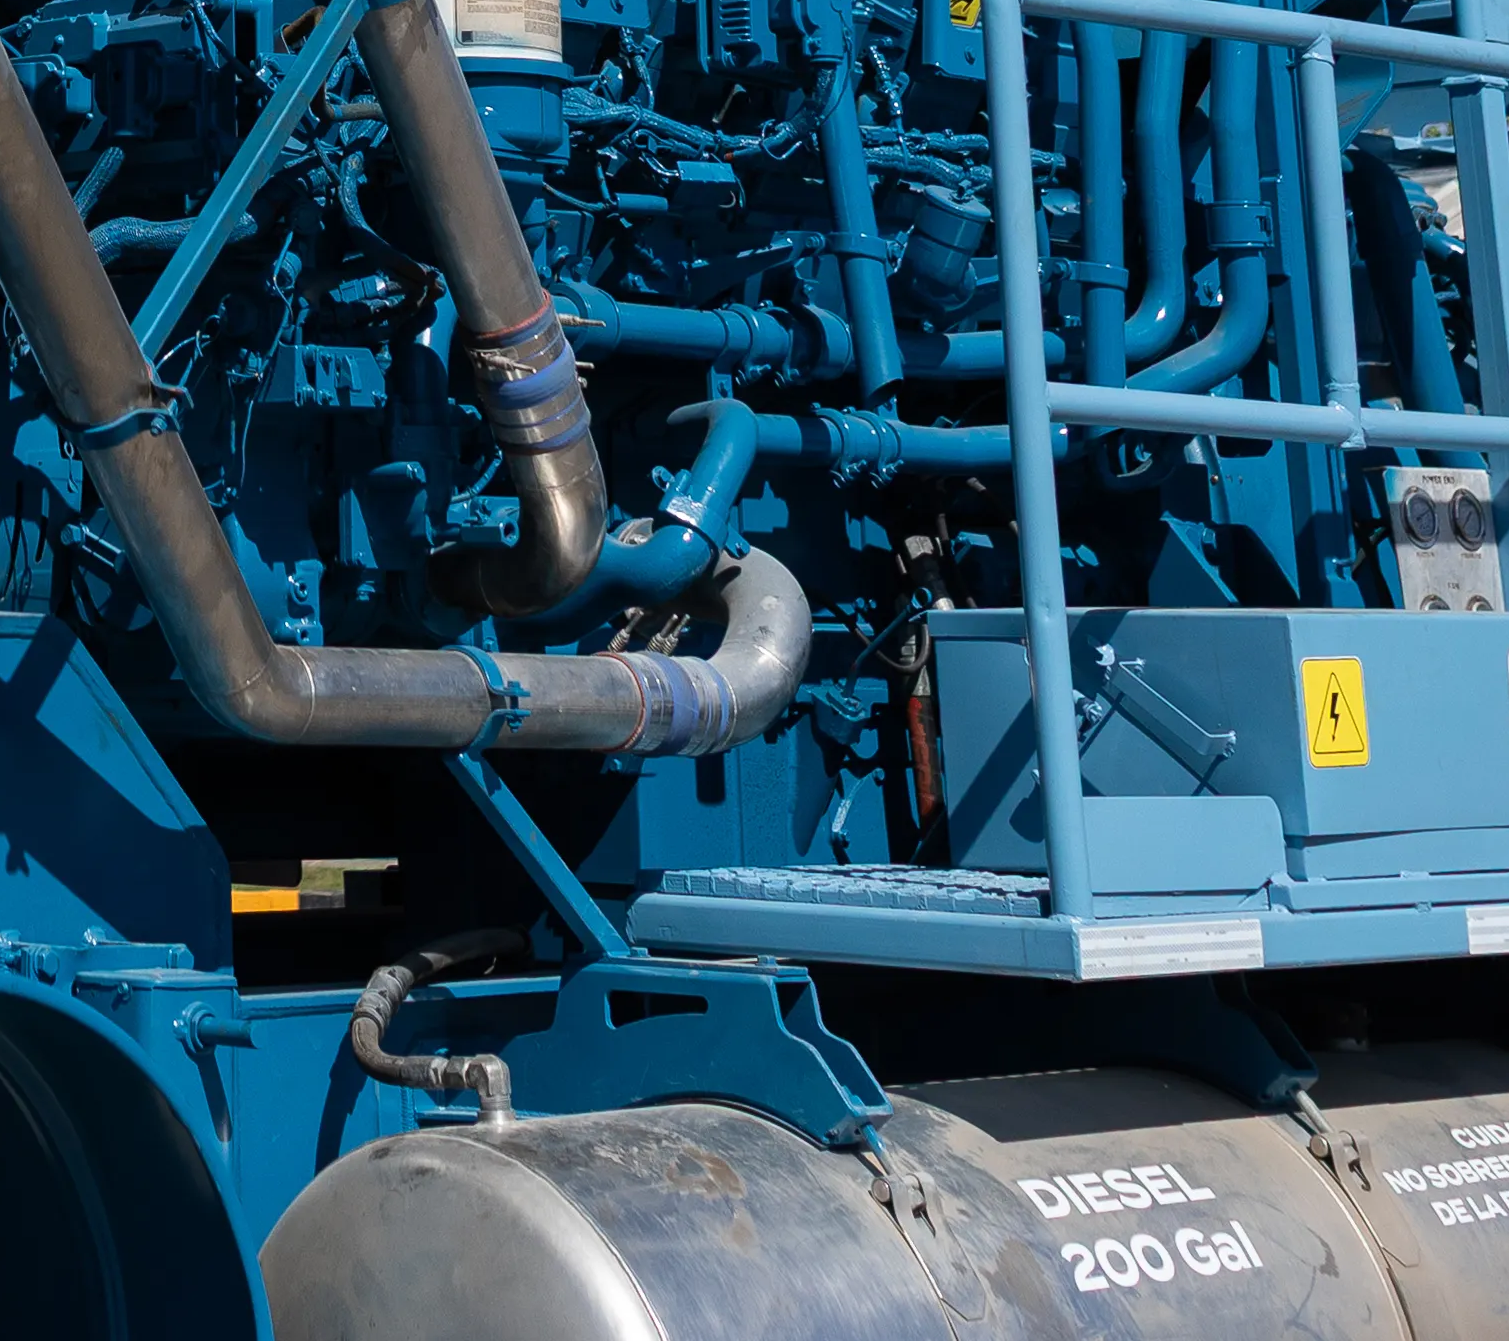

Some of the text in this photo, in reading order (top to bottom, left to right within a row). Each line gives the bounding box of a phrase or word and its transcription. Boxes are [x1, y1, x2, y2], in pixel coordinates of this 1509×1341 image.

[1016, 1163, 1217, 1219] DIESEL
[1382, 1167, 1429, 1195] NO
[1431, 1196, 1475, 1226] DE
[1468, 1191, 1508, 1221] LA
[1060, 1220, 1264, 1292] 200 Gal
